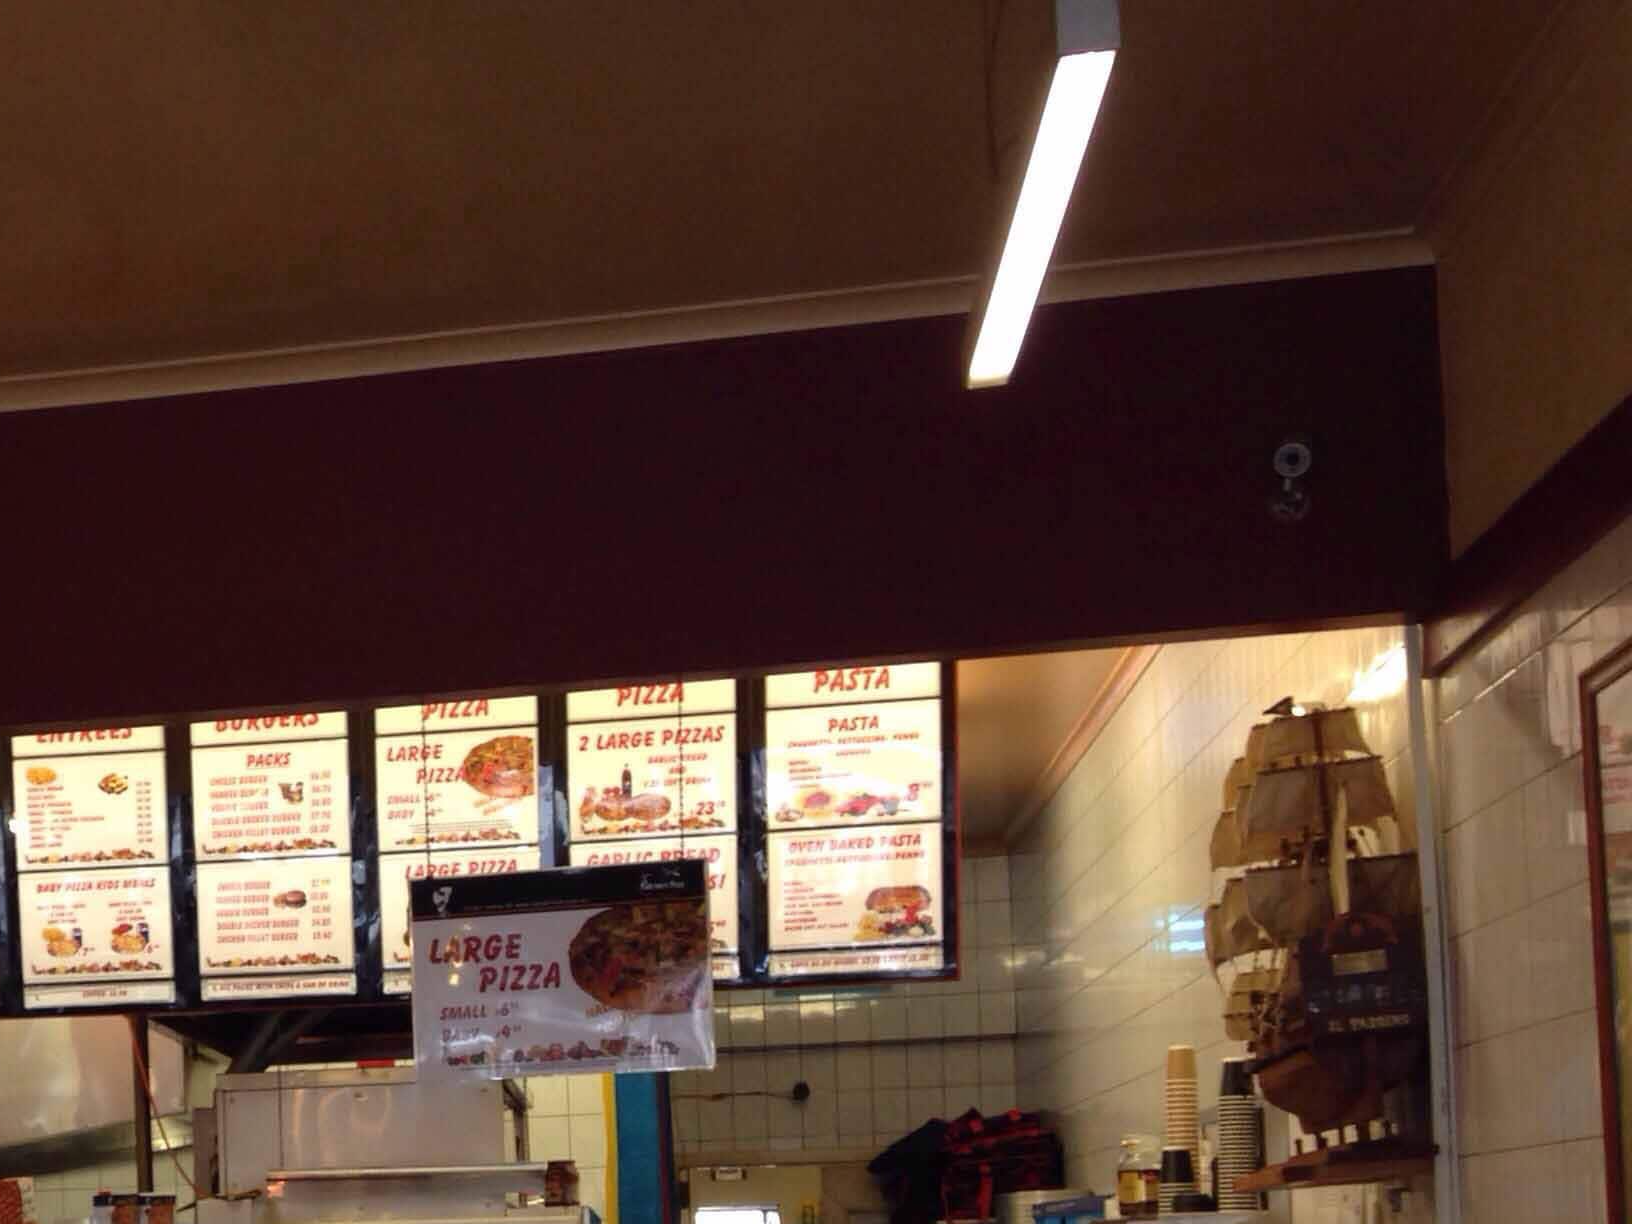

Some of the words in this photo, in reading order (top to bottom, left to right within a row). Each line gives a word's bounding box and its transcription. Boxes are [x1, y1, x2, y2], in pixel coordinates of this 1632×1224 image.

[813, 667, 890, 693] PASTA
[616, 682, 684, 707] PIZZA
[422, 700, 489, 720] PIZZA
[828, 715, 880, 732] PASTA
[596, 731, 655, 750] LARGE
[661, 725, 725, 746] PIZZAS
[246, 752, 291, 768] PACKS
[386, 744, 444, 762] LARGE
[416, 766, 466, 784] PIZZA
[404, 862, 462, 880] LARGE
[468, 859, 519, 875] PIZZA
[428, 933, 523, 965] LARGE
[479, 962, 562, 993] PIZZA
[439, 1005, 488, 1021] SMALL
